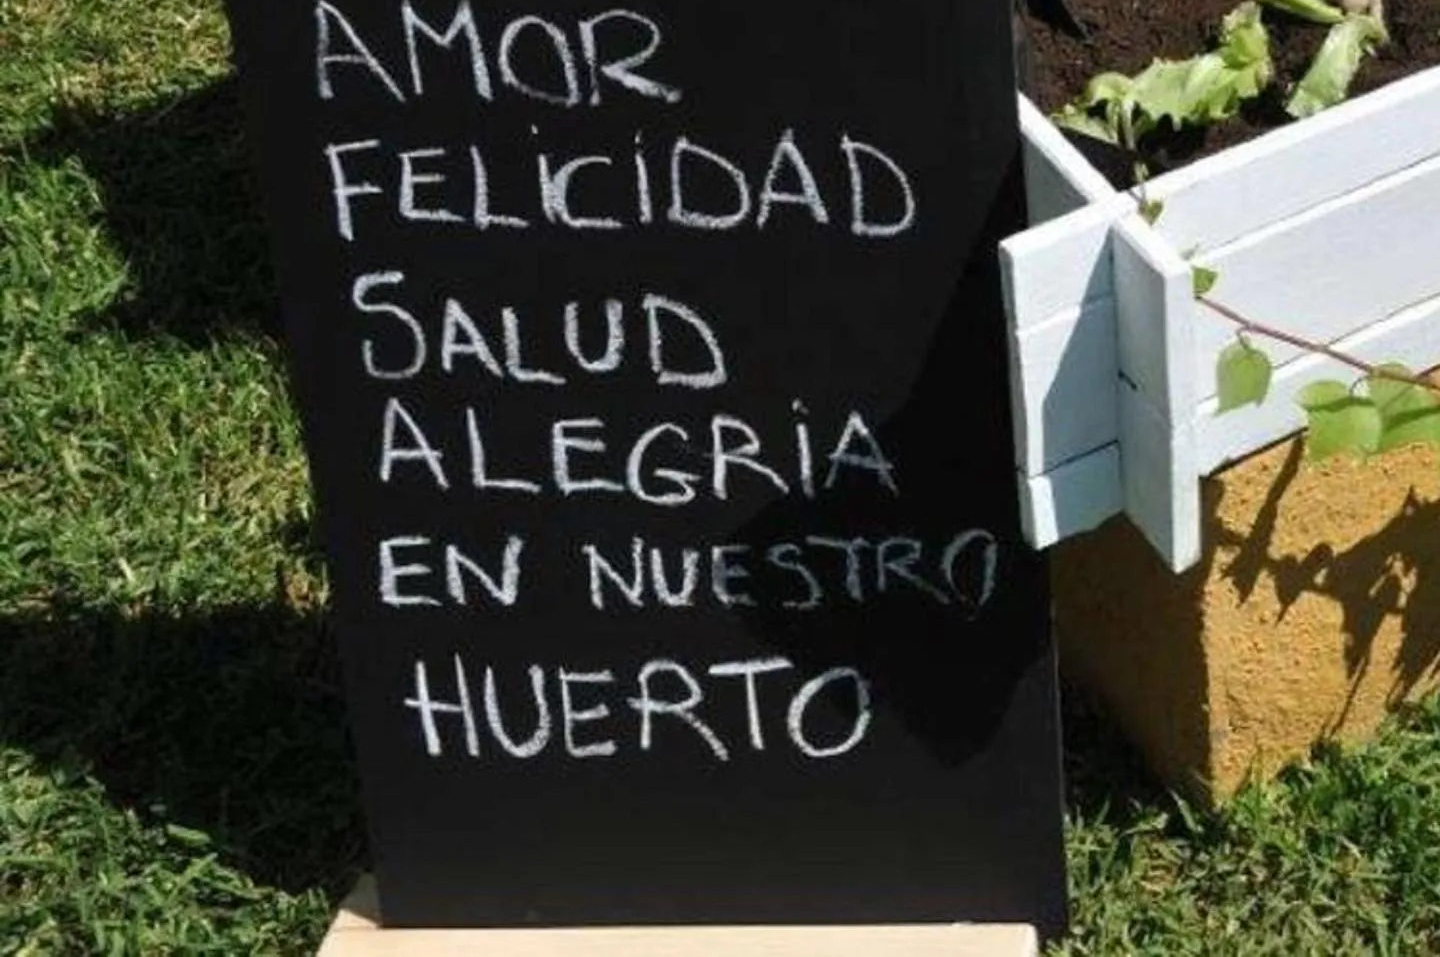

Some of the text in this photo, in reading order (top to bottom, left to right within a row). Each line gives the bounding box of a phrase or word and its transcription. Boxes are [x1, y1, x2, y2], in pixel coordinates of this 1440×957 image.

[352, 271, 728, 389] SALUD
[379, 529, 997, 620] EN NUESTRO
[404, 653, 872, 762] HUERTO
